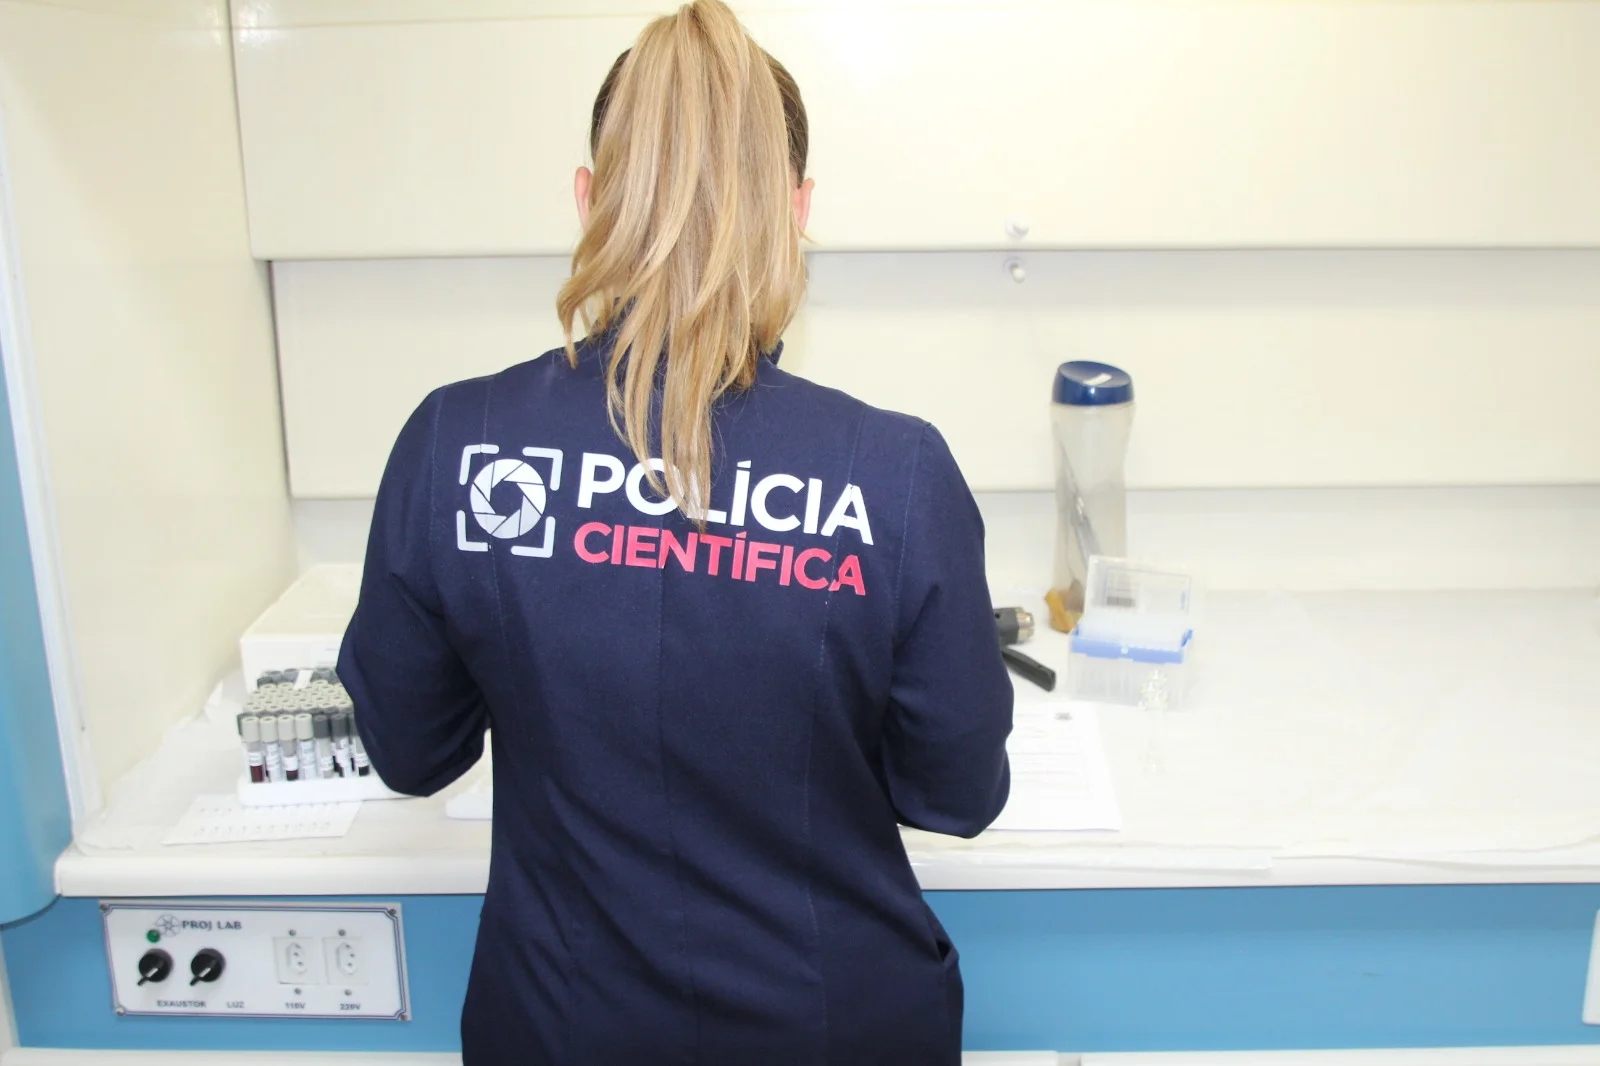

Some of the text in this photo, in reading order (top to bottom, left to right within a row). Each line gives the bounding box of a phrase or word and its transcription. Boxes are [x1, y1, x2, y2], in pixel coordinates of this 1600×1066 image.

[574, 522, 866, 596] CIENTÍFICA
[182, 920, 242, 931] PROJ LAB
[157, 1000, 206, 1008] EXAUSTOR
[227, 1001, 245, 1009] LUZ
